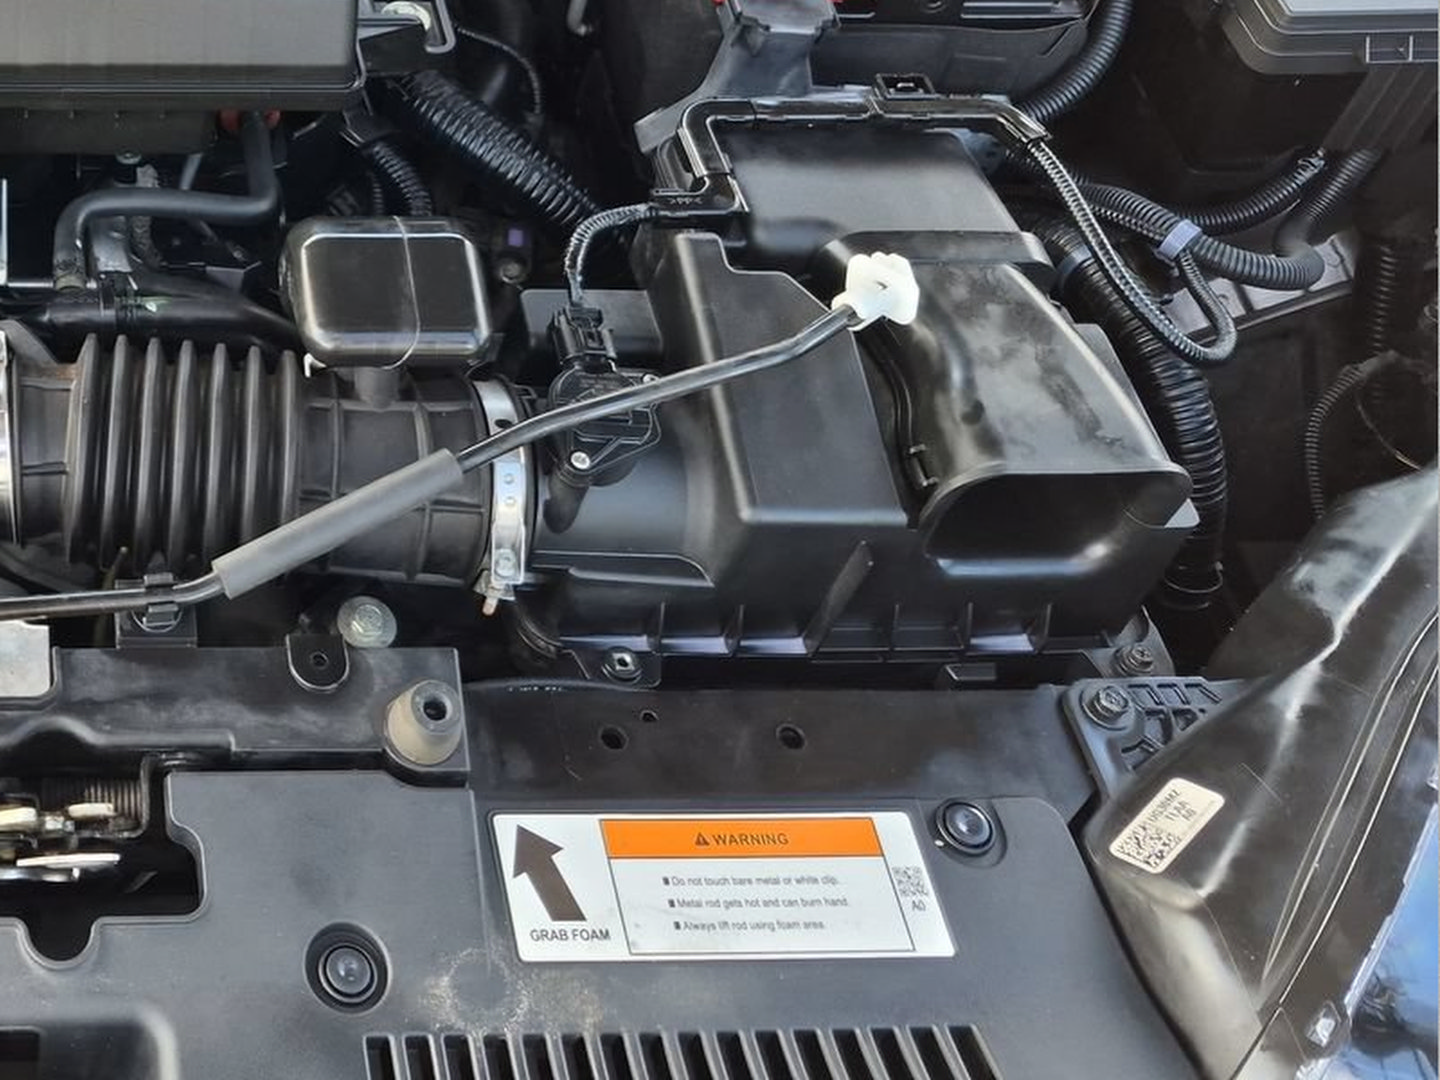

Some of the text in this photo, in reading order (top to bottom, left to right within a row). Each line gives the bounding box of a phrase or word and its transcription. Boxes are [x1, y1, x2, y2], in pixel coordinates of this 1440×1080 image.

[712, 833, 789, 846] WARNING
[671, 876, 686, 886] Do
[688, 877, 702, 886] not
[704, 877, 729, 886] touch
[731, 876, 753, 885] bare
[755, 876, 780, 885] metal
[782, 877, 791, 885] or
[794, 875, 819, 885] white
[676, 899, 702, 908] Metal
[704, 899, 721, 908] rod
[722, 899, 743, 910] gets
[744, 898, 760, 907] hot
[762, 898, 779, 907] and
[781, 899, 798, 907] can
[799, 898, 822, 906] burn
[683, 921, 716, 932] Always
[717, 921, 729, 930] lift
[731, 921, 748, 930] rod
[750, 921, 775, 932] using
[776, 920, 800, 929] foam
[530, 928, 611, 941] GRAB FOAM
